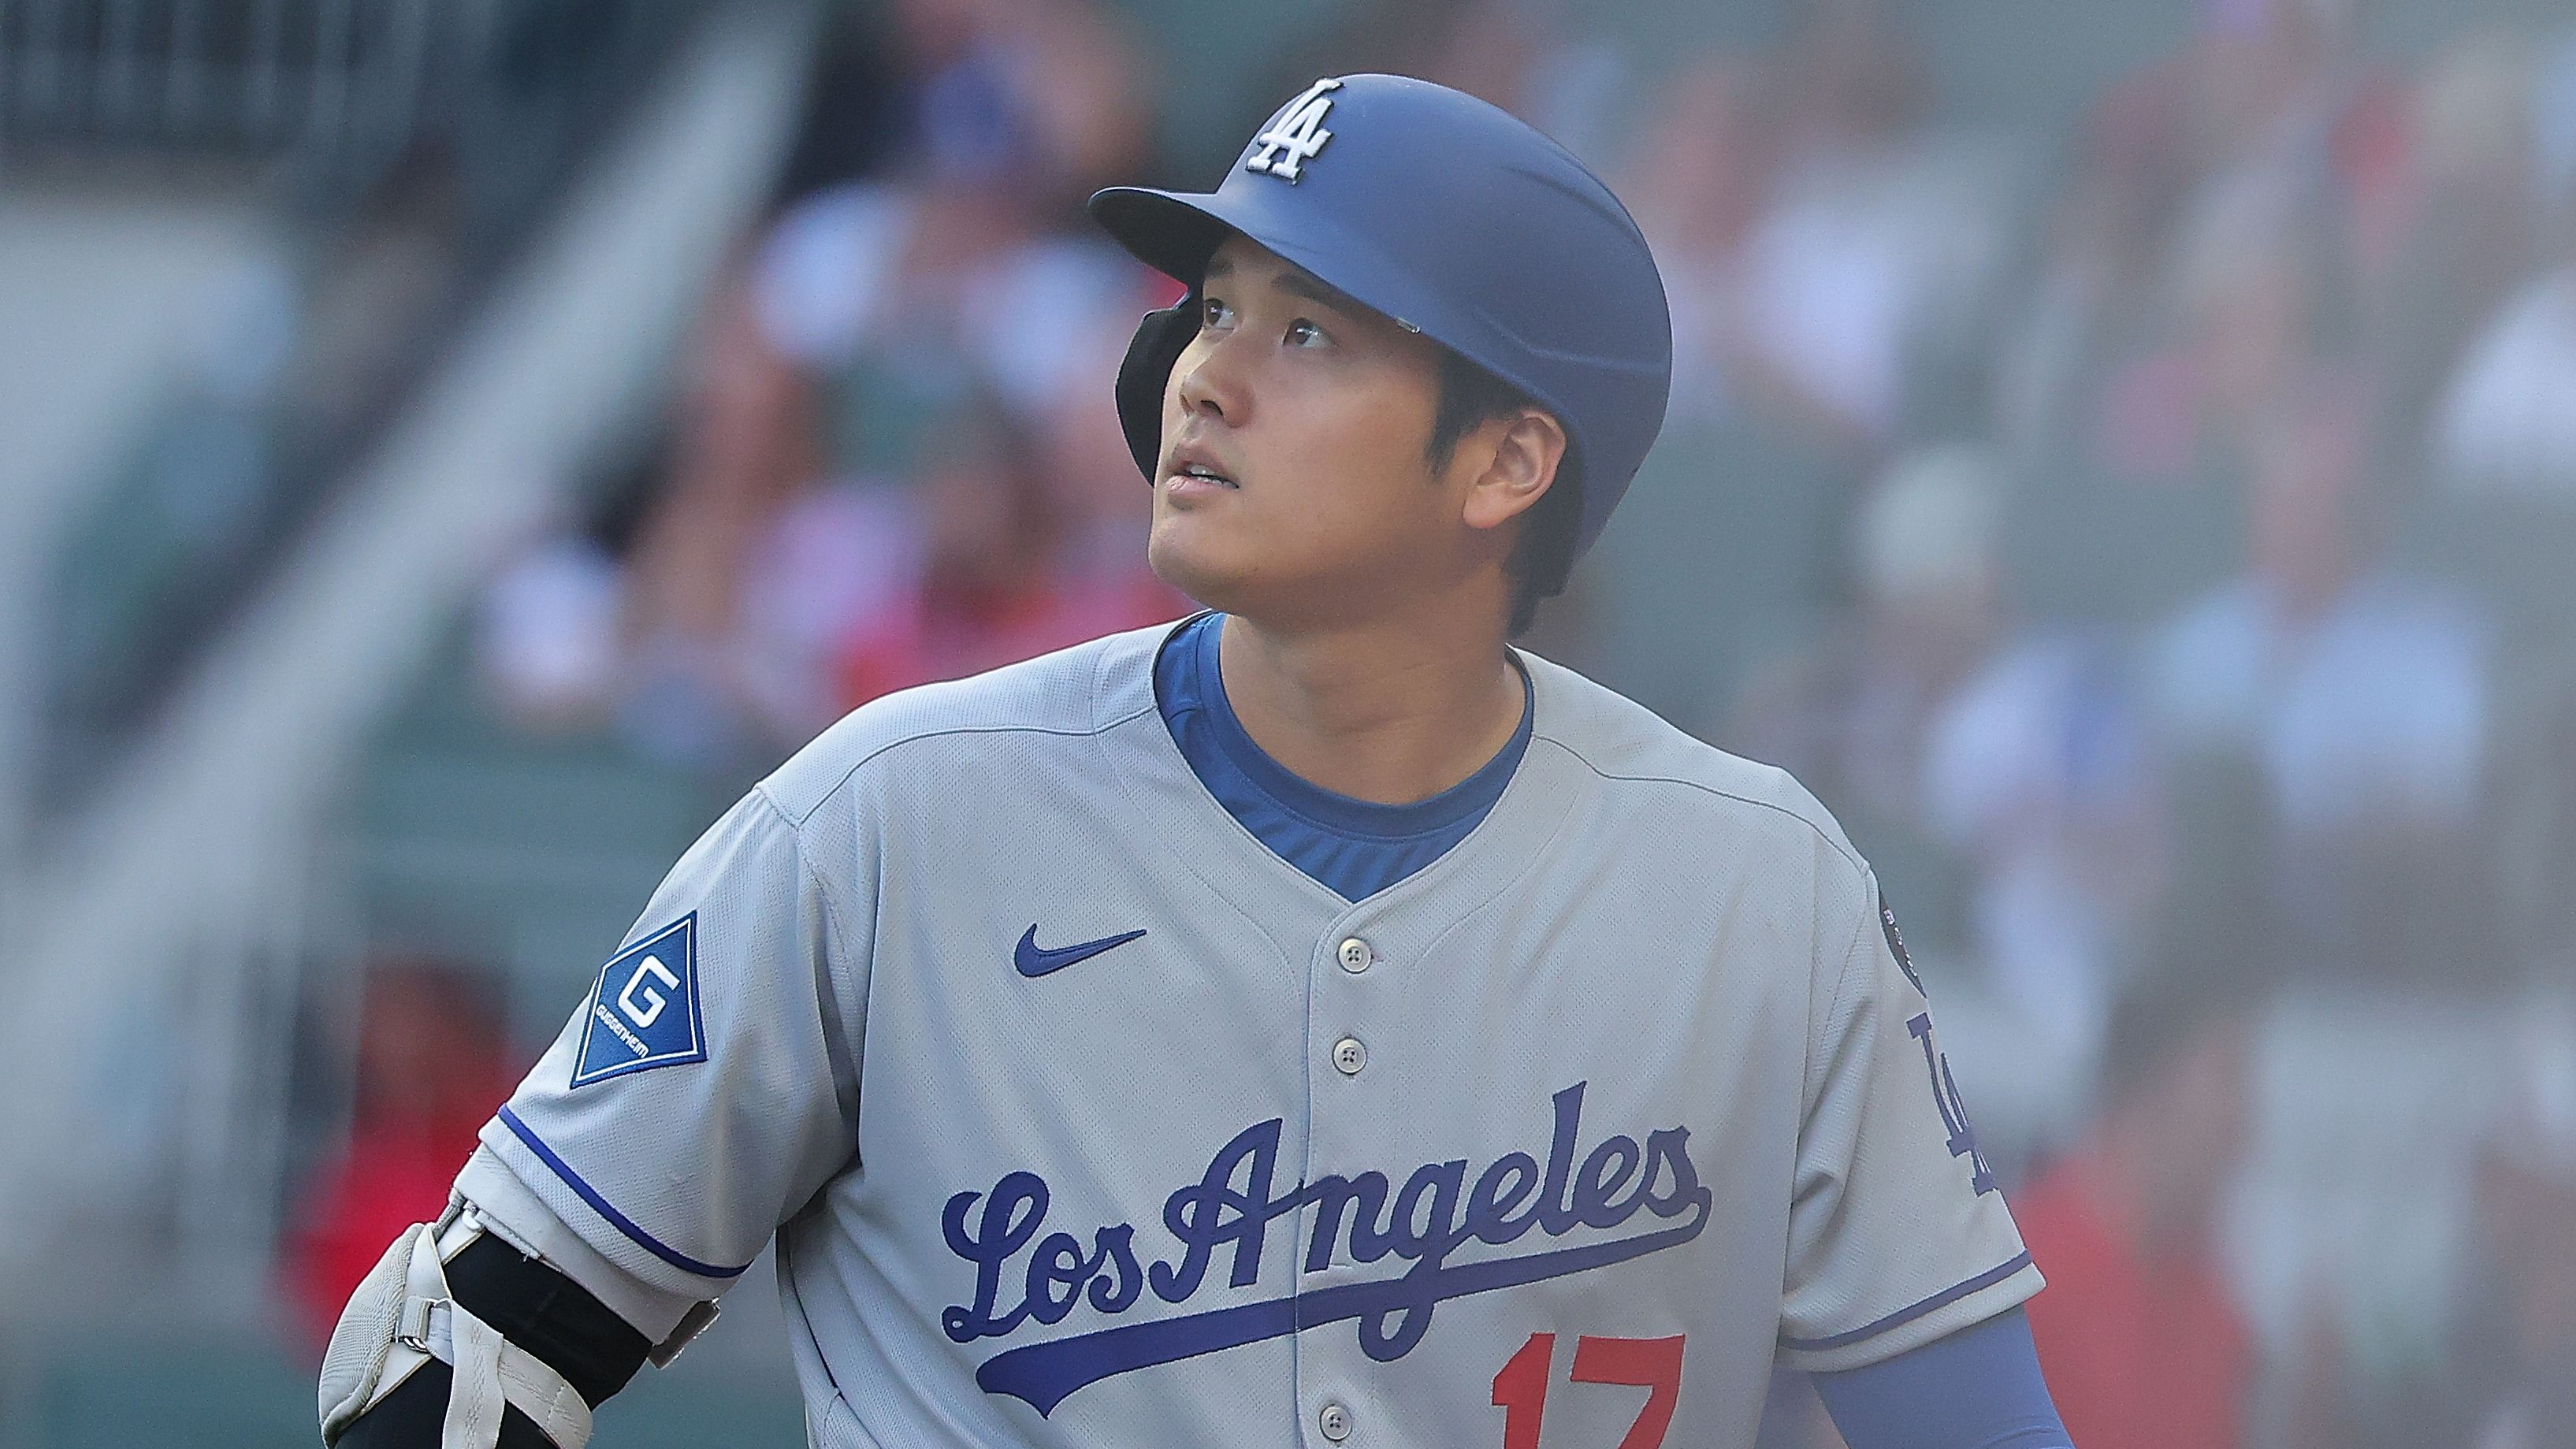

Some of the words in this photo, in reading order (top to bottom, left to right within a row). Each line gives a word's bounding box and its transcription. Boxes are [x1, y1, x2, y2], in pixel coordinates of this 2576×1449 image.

[1246, 77, 1343, 184] LA
[596, 1004, 650, 1058] GUGGENHEIM
[618, 954, 681, 1027] G
[942, 1171, 1143, 1343] Los
[1148, 1080, 1712, 1362] Angeles
[1491, 1332, 1686, 1449] 17
